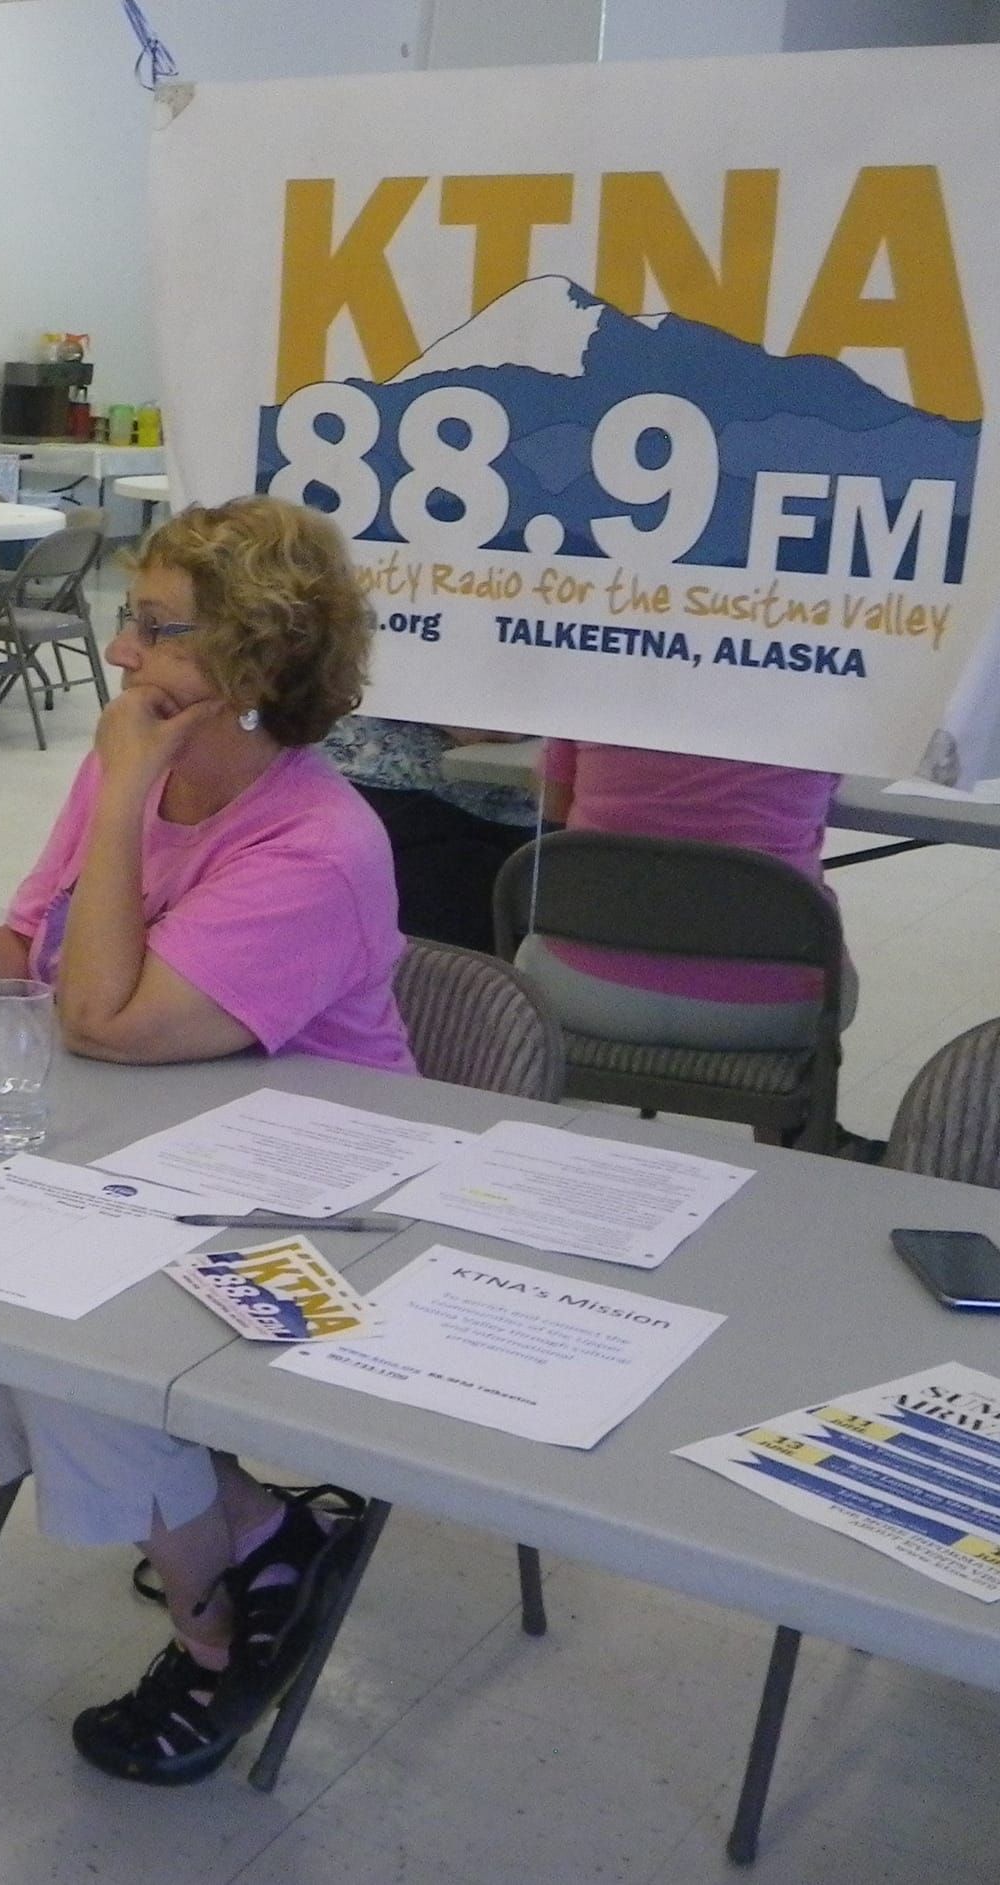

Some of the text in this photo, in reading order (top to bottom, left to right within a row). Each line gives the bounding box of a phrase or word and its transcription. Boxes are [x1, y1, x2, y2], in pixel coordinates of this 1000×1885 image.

[275, 164, 984, 422] KTNA
[266, 381, 956, 584] 88.9 FM
[432, 563, 522, 599] Radio
[532, 567, 594, 605] for
[605, 566, 670, 615] the
[683, 578, 831, 629] Susitna
[842, 593, 950, 650] Valley
[370, 611, 867, 678] .org TALKEETNA, ALASKA
[209, 1274, 281, 1318] 88.9
[231, 1257, 362, 1338] KTNA
[448, 1266, 675, 1330] KTNA's Mission
[773, 1436, 805, 1450] 13
